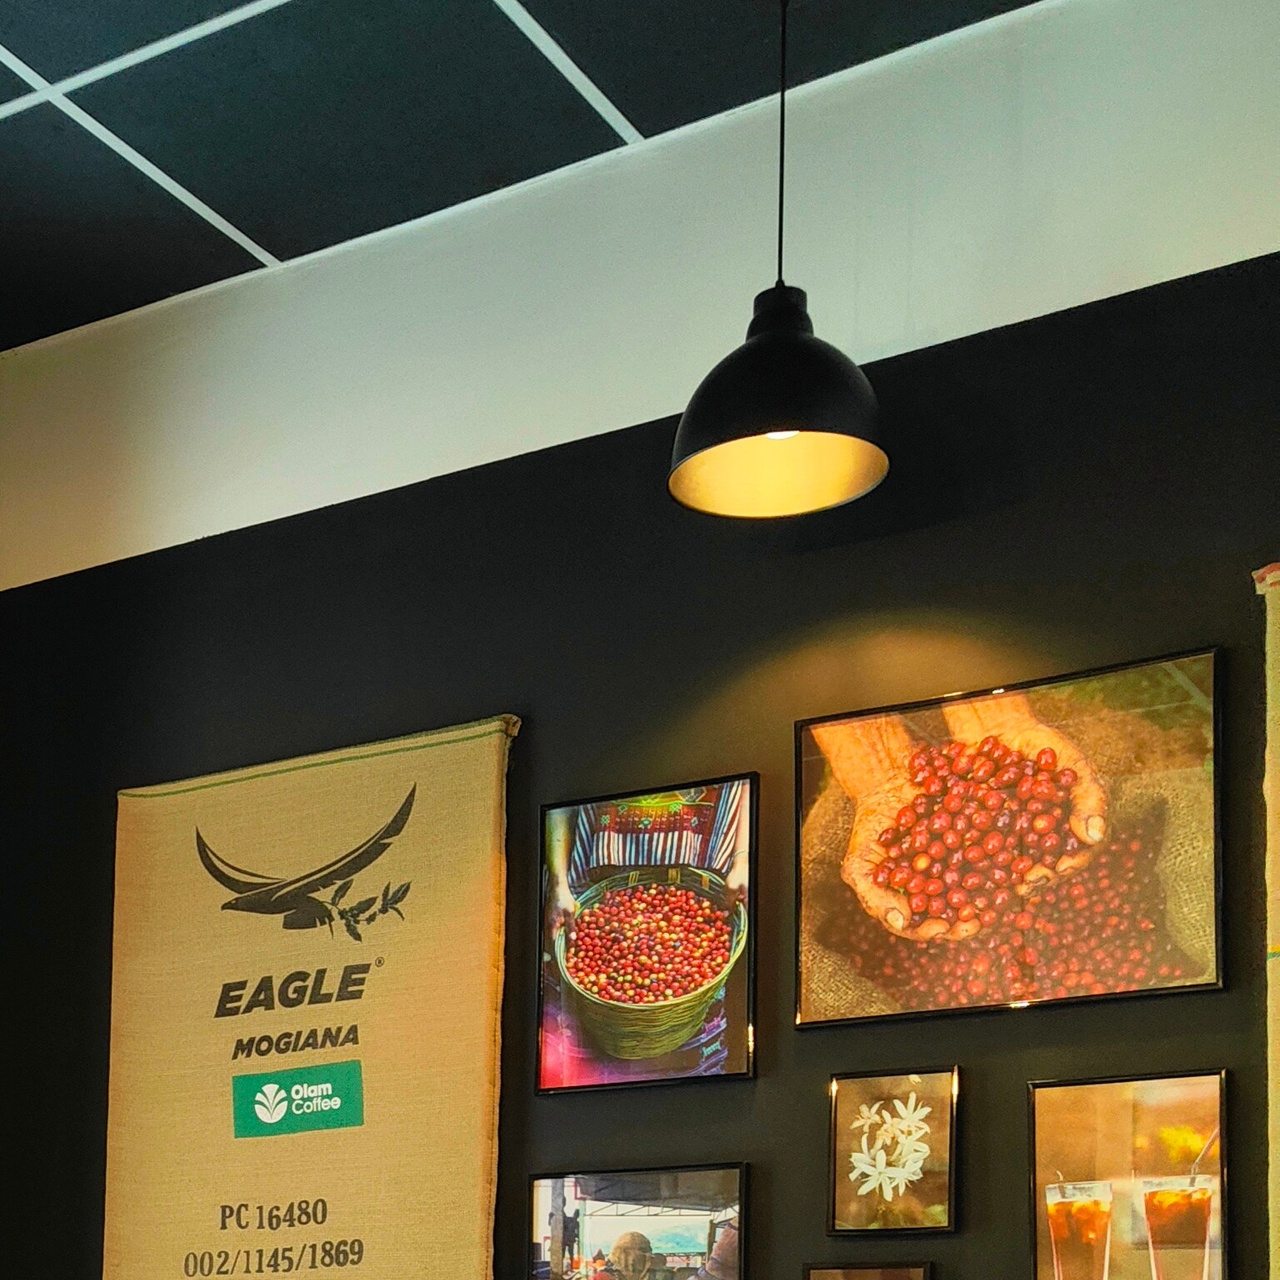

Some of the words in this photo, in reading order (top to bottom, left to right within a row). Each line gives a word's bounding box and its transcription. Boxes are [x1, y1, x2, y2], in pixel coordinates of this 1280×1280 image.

[214, 963, 372, 1018] EAGLE
[232, 1024, 360, 1060] MOGIANA
[291, 1083, 332, 1100] Olam
[291, 1096, 342, 1115] Coffee
[220, 1203, 250, 1230] PC
[256, 1199, 328, 1231] 16480
[183, 1239, 364, 1277] 002/1145/1869
